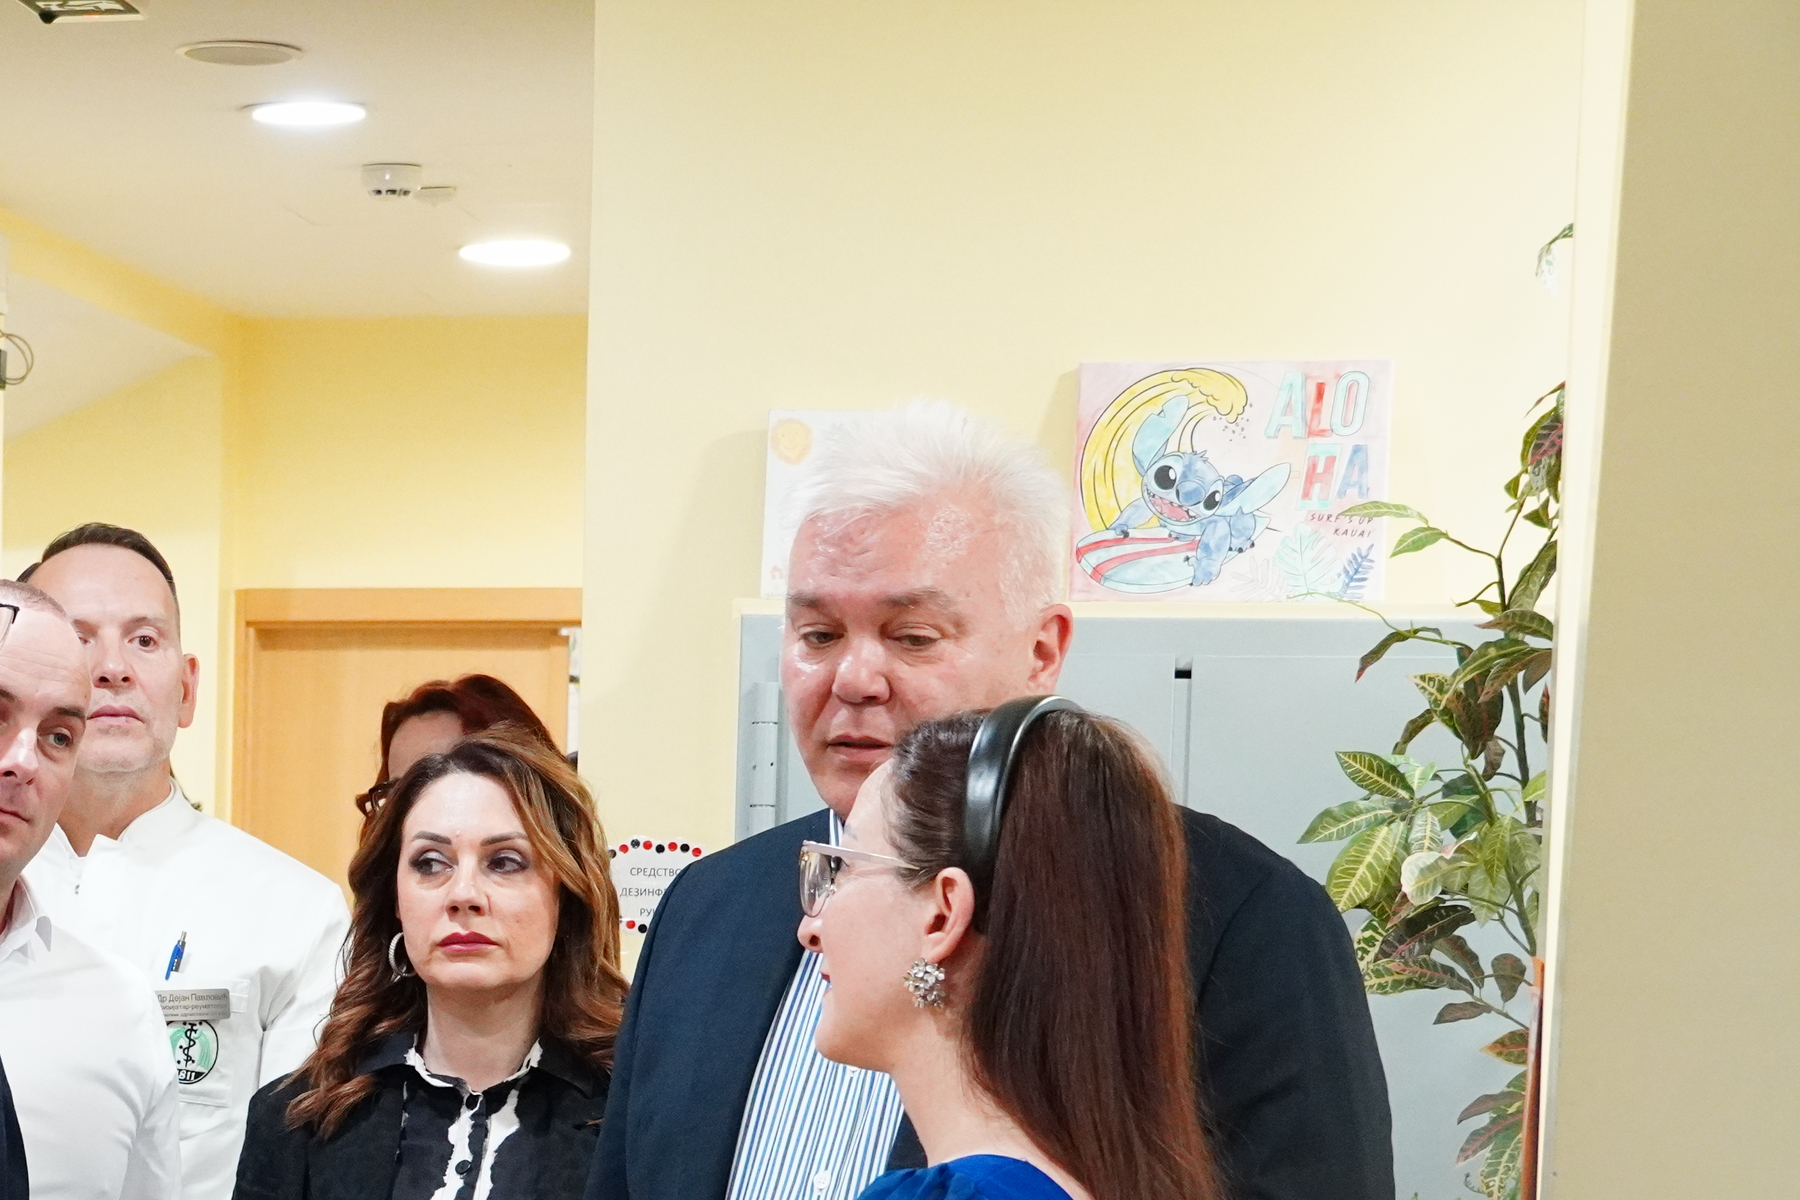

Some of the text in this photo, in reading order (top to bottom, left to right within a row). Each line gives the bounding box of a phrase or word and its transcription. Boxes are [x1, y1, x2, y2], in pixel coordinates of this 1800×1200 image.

[1264, 370, 1370, 439] ALO
[1301, 444, 1369, 500] HA
[1358, 516, 1374, 525] UP
[1333, 527, 1372, 538] KAUAI
[620, 887, 667, 897] ДЕЗИНФ
[640, 908, 655, 917] РУ
[178, 1069, 195, 1080] 811
